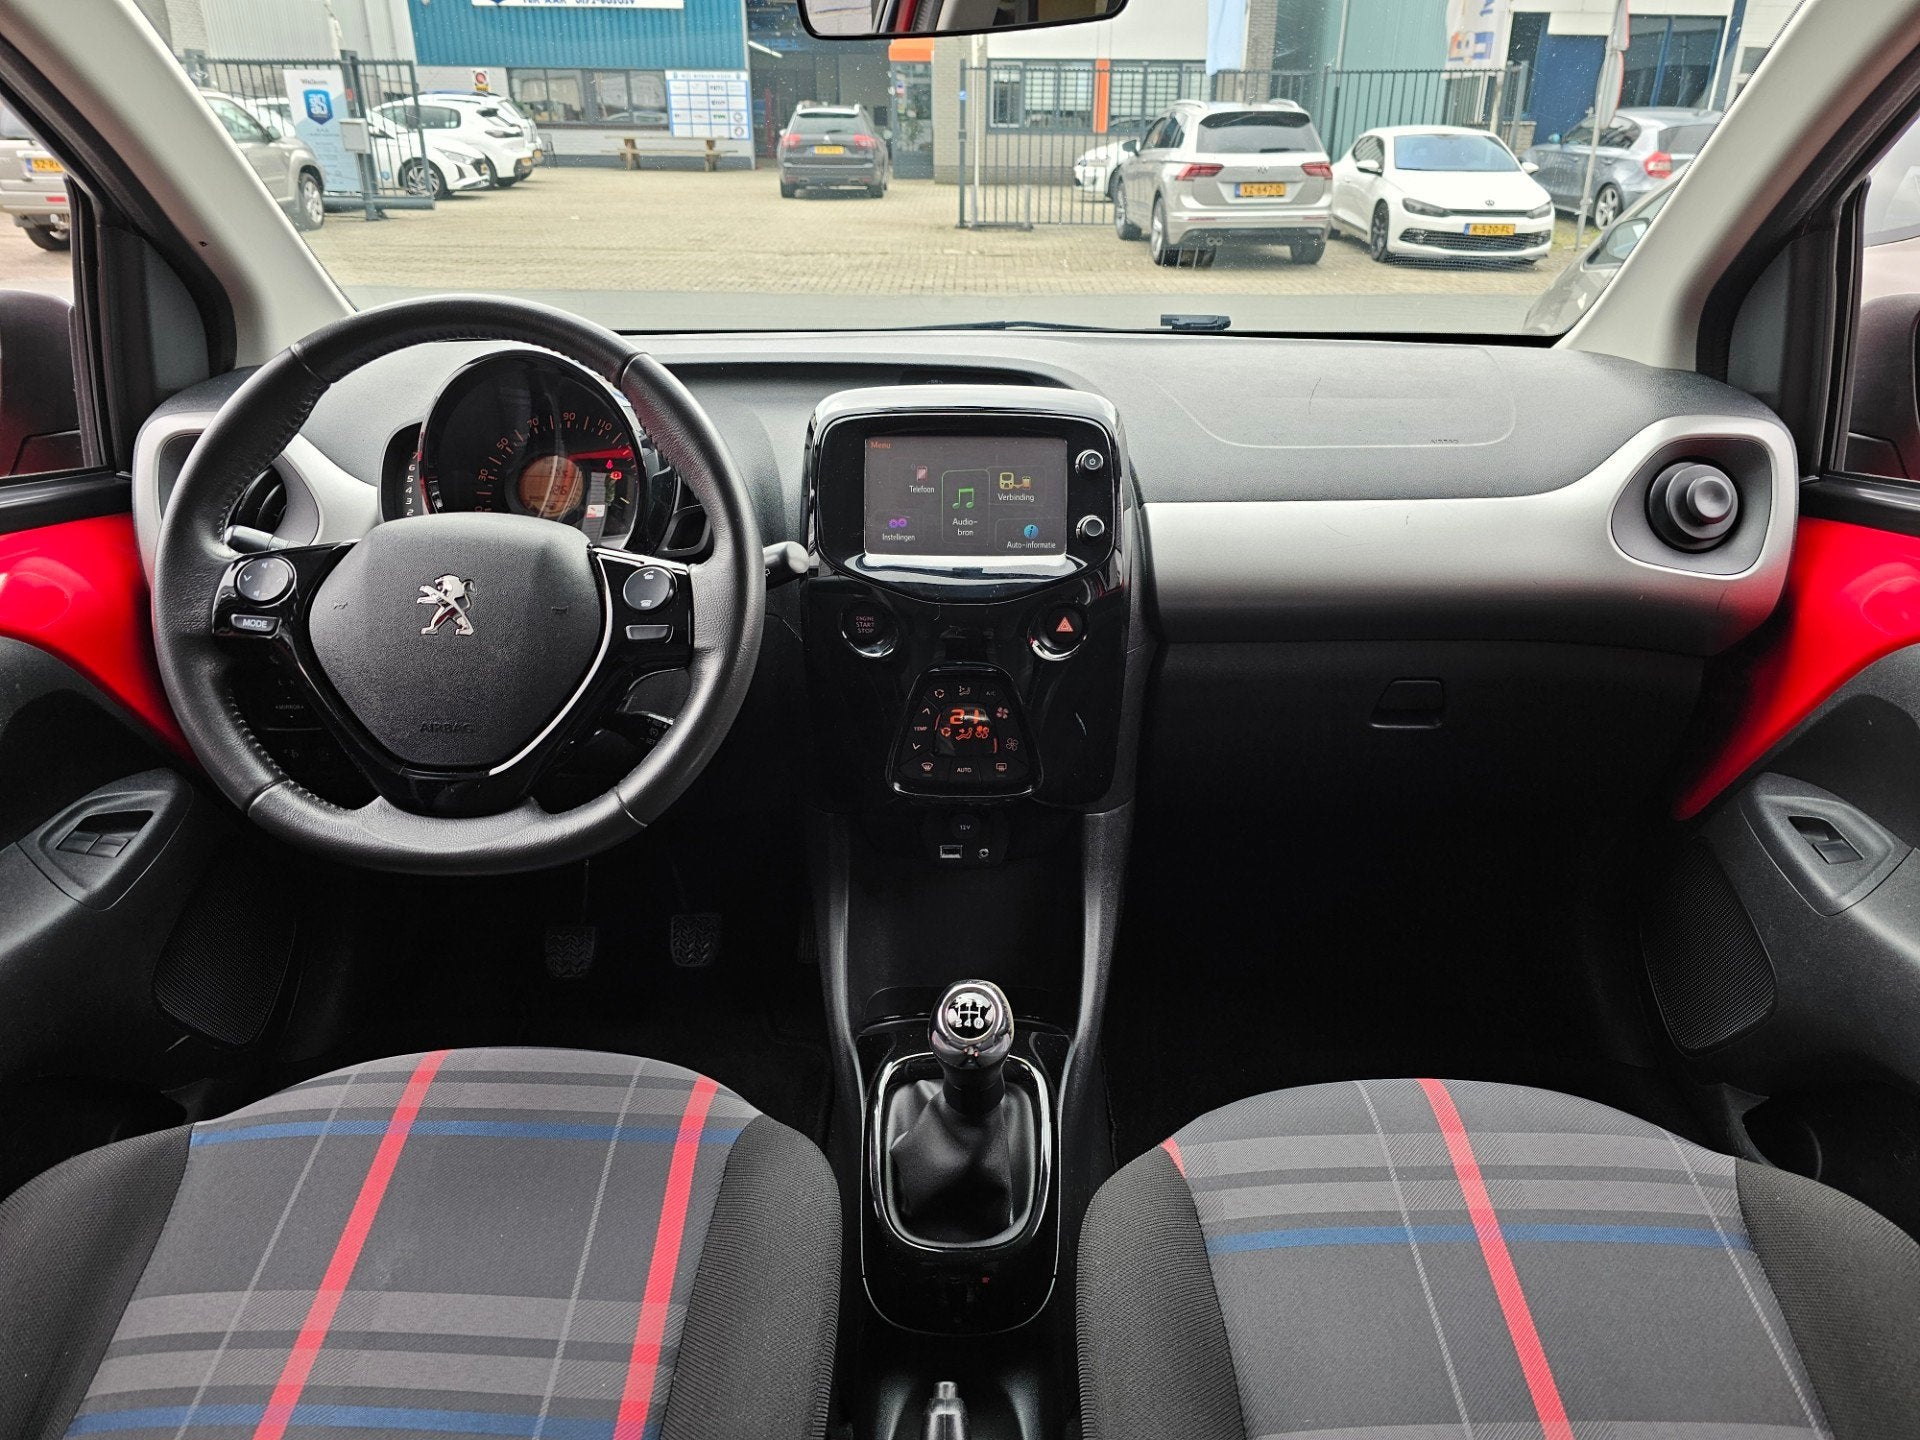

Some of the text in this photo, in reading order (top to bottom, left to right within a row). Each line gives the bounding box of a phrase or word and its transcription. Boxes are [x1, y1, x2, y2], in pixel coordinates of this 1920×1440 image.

[563, 412, 576, 421] 90
[527, 417, 539, 428] 70
[597, 419, 613, 431] 110
[496, 437, 509, 449] 50
[406, 475, 414, 483] 5
[479, 468, 489, 482] 30
[405, 486, 413, 494] 4
[909, 485, 935, 494] Telefoon
[405, 497, 412, 505] 3
[997, 493, 1035, 502] Verbinding
[406, 508, 414, 516] 2
[952, 518, 978, 526] Audio-
[882, 533, 916, 542] Instellingen
[1006, 541, 1056, 549] Auto-informatie
[242, 618, 268, 629] MODE
[950, 708, 979, 725] 21
[420, 722, 474, 735] AIRBAG
[955, 1019, 963, 1028] 2
[964, 1019, 972, 1028] 4
